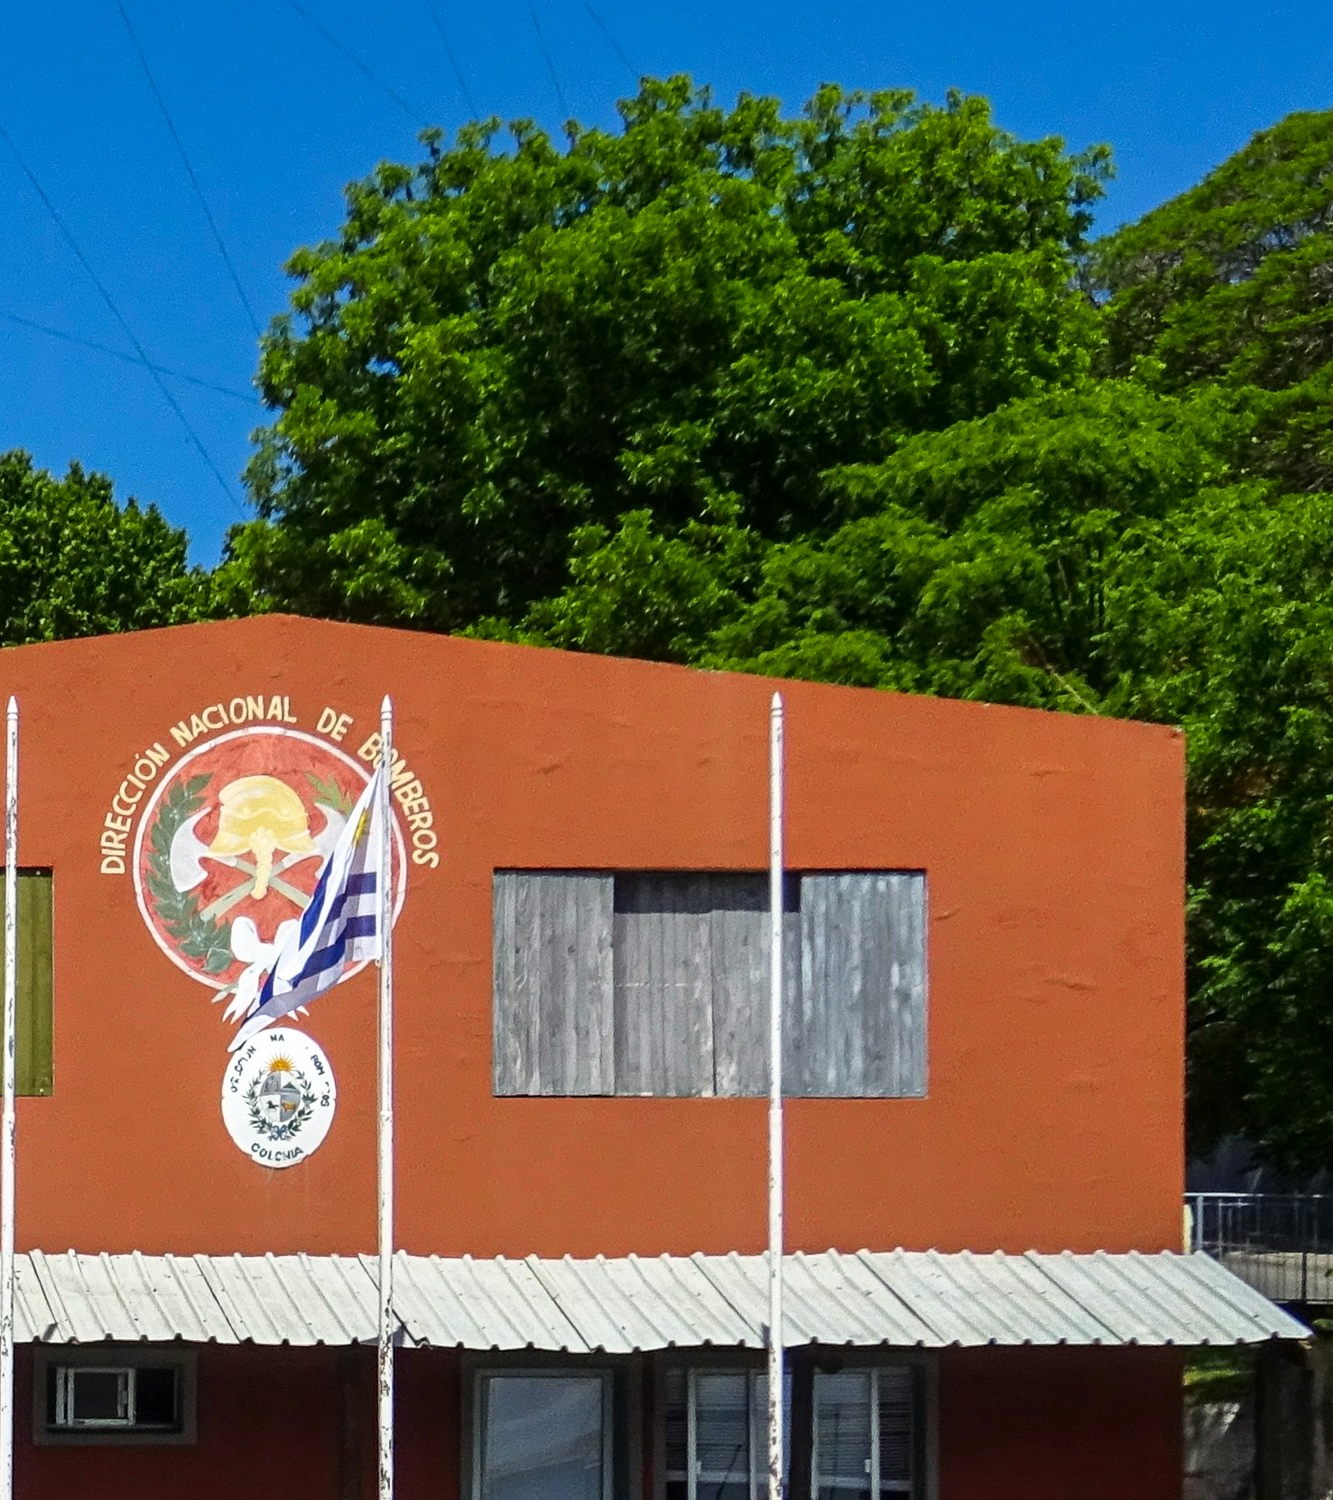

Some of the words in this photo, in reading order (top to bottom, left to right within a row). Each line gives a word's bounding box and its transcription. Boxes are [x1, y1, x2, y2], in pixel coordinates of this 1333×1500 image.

[101, 742, 170, 875] DIRECCIÓN
[170, 695, 297, 747] NACIONAL
[316, 707, 354, 742] DE
